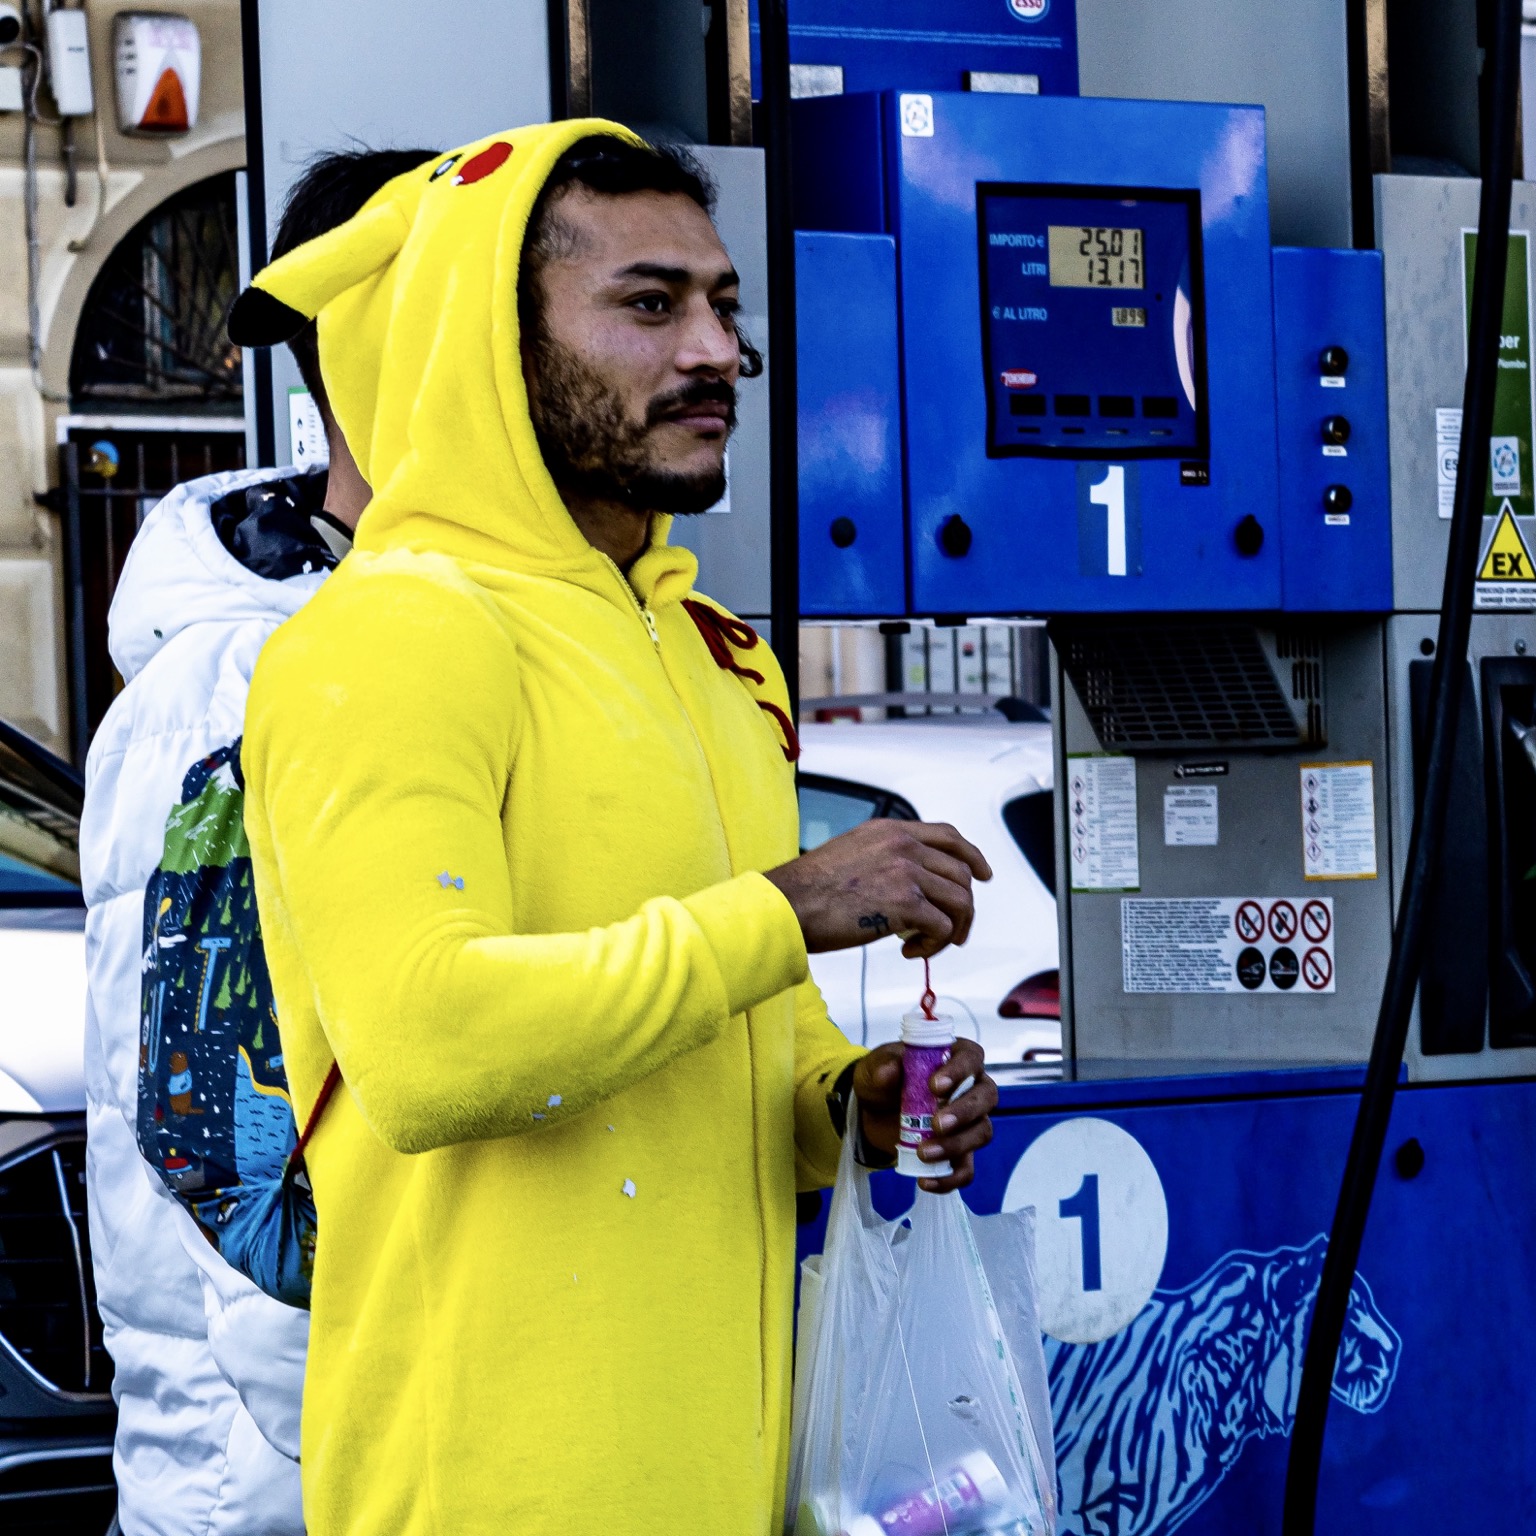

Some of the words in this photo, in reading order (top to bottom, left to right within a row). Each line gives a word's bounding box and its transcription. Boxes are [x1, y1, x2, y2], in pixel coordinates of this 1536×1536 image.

[990, 234, 1036, 247] IMPORTO
[1079, 228, 1139, 257] 25.01
[1022, 263, 1046, 275] LITRI
[1088, 258, 1139, 286] 13.17
[1003, 308, 1017, 320] AL
[1019, 308, 1048, 321] LITRO
[1090, 465, 1127, 576] 1
[1491, 552, 1523, 577] EX
[1058, 1173, 1102, 1292] 1
